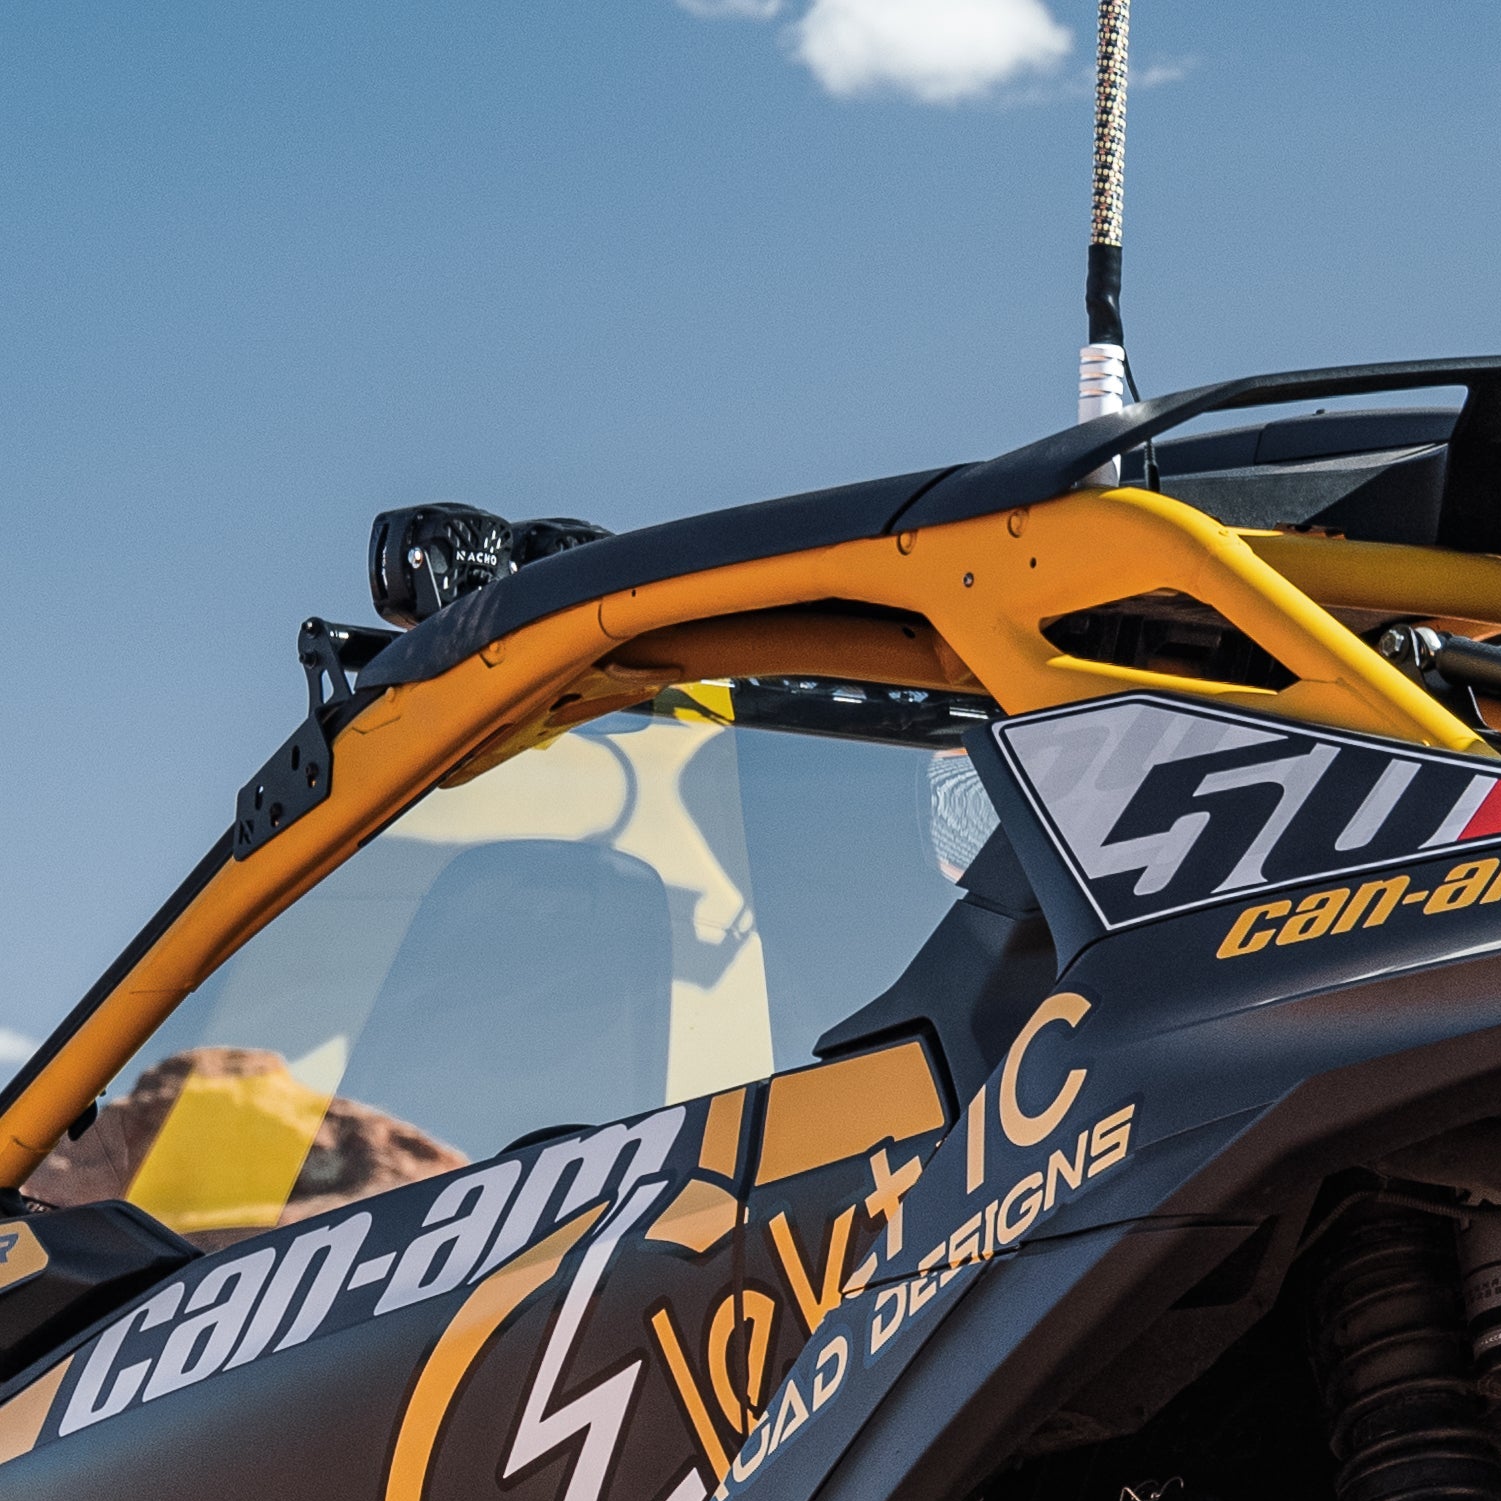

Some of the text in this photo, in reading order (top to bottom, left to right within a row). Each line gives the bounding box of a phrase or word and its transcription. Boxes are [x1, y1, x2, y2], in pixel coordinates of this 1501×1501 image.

[456, 550, 497, 566] NACHO
[58, 1105, 687, 1438] can-am
[871, 1103, 1136, 1356] DESIGNS
